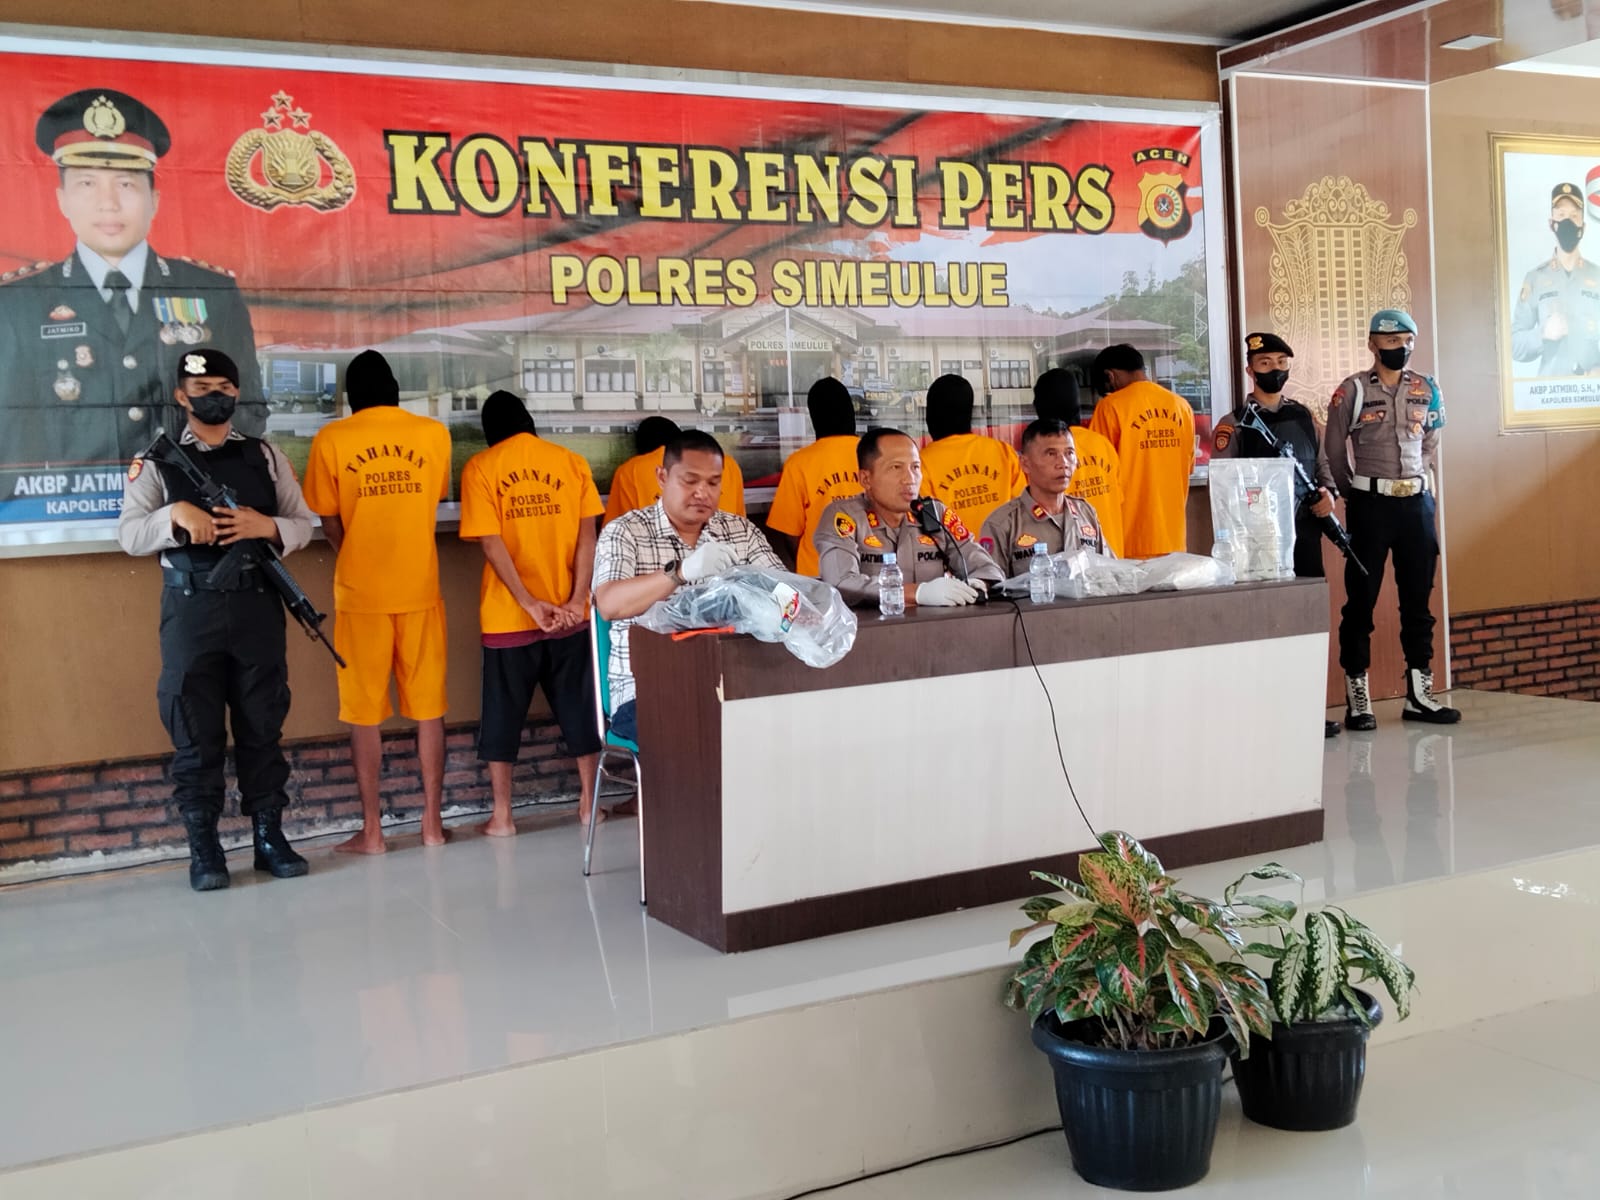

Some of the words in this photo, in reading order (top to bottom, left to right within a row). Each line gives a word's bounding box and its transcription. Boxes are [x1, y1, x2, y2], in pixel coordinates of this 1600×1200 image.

[1136, 148, 1188, 165] ACEH
[383, 130, 921, 229] KONFERENSI
[936, 156, 1115, 235] PERS
[550, 255, 758, 307] POLRES
[772, 259, 1010, 308] SIMEULUE
[750, 340, 784, 350] POLRES
[787, 341, 829, 350] IMEULUE
[345, 444, 426, 474] TAHANAN
[14, 473, 67, 496] AKBP
[365, 470, 411, 485] POLRES
[816, 471, 860, 496] TAHAN
[938, 463, 1000, 491] TAHANAN
[357, 482, 423, 498] SIMEULUE
[953, 484, 989, 500] POLRES
[46, 498, 125, 515] KAPOLRES
[951, 492, 999, 510] IMEULUE
[505, 504, 561, 521] SIMEULUE
